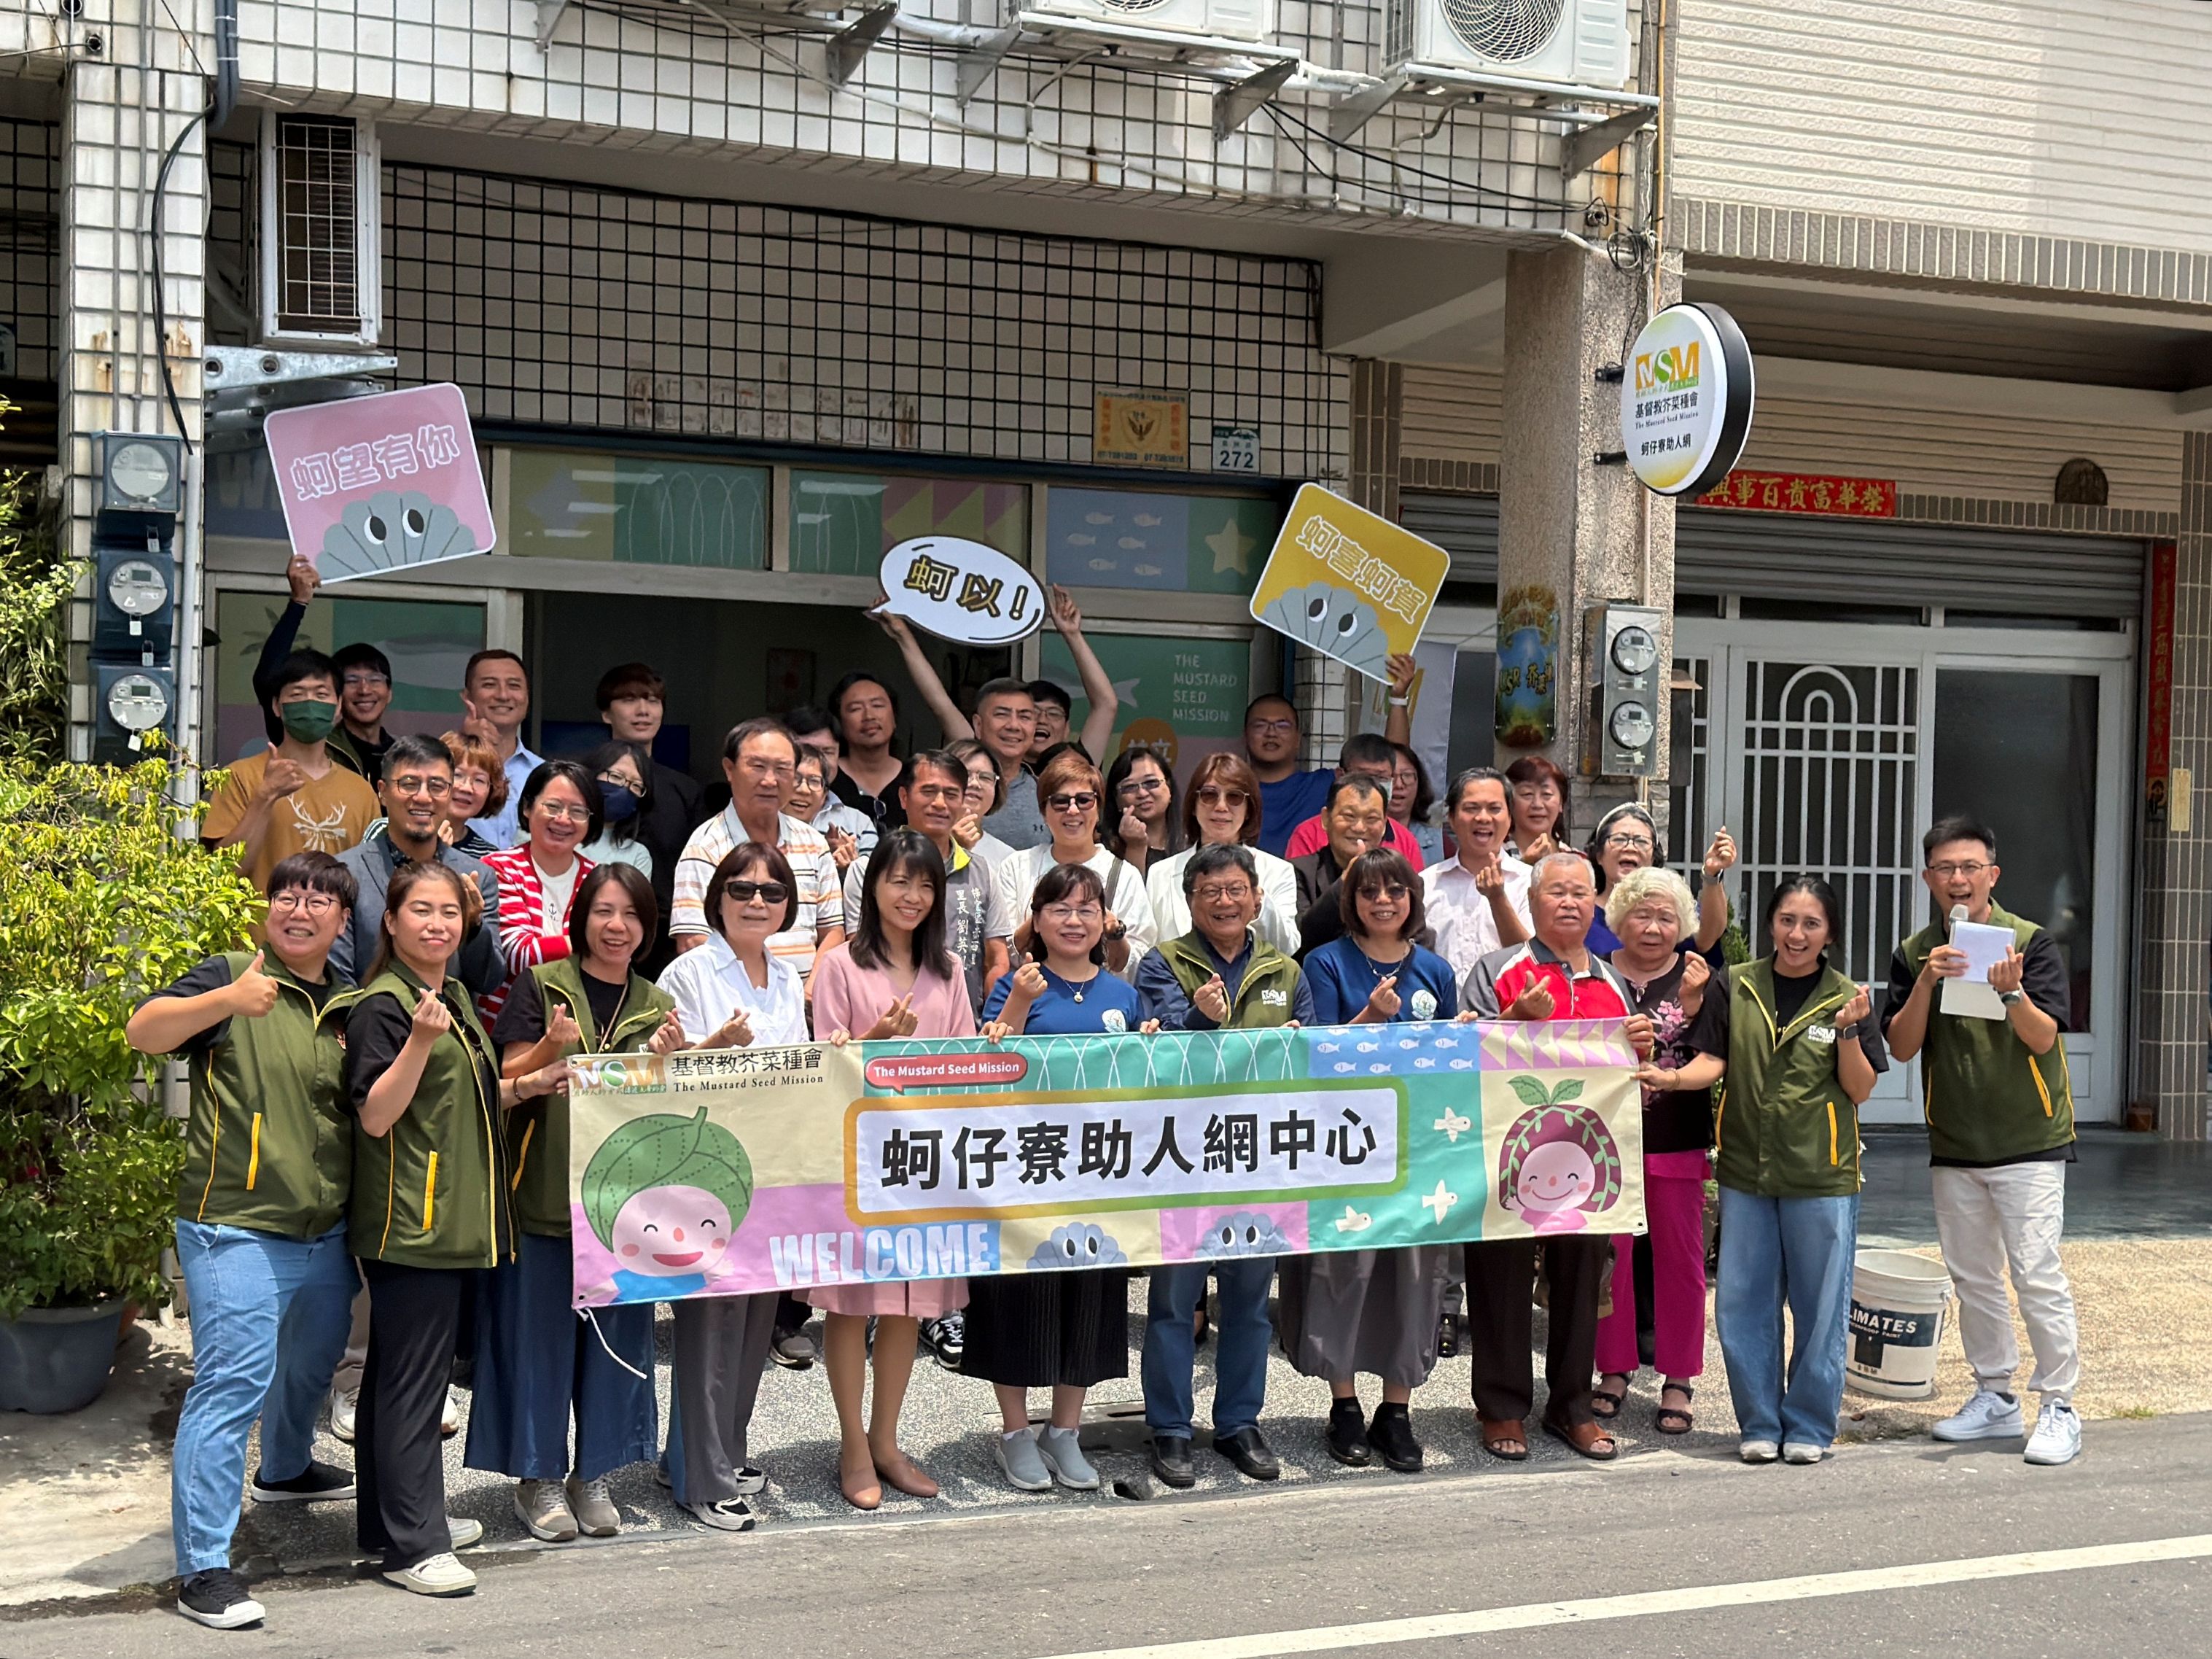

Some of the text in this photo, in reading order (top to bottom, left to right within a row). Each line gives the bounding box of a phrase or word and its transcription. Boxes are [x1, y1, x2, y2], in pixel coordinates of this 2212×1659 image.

[1635, 392, 1698, 419] 基督教芥菜種會
[1646, 417, 1665, 427] Mustard
[1680, 412, 1699, 420] Mission
[1641, 433, 1691, 456] 蚵仔寮助人網
[290, 424, 460, 501] 蚵望有你
[1220, 450, 1254, 469] 272
[1296, 515, 1427, 624] 蚵喜蚵賀
[1175, 653, 1200, 668] THE
[1173, 672, 1237, 687] MUSTARD
[1173, 689, 1207, 704] SEED
[1172, 707, 1229, 722] MISSION
[957, 920, 969, 971] 劉英
[671, 1047, 823, 1076] 基督教芥菜種會
[874, 1062, 1019, 1077] The Mustard Seed Mission
[674, 1073, 824, 1092] The Mustard Seed Mission
[881, 1108, 1376, 1191] 蚵仔寮助人網中心
[769, 1224, 991, 1286] WELCOME
